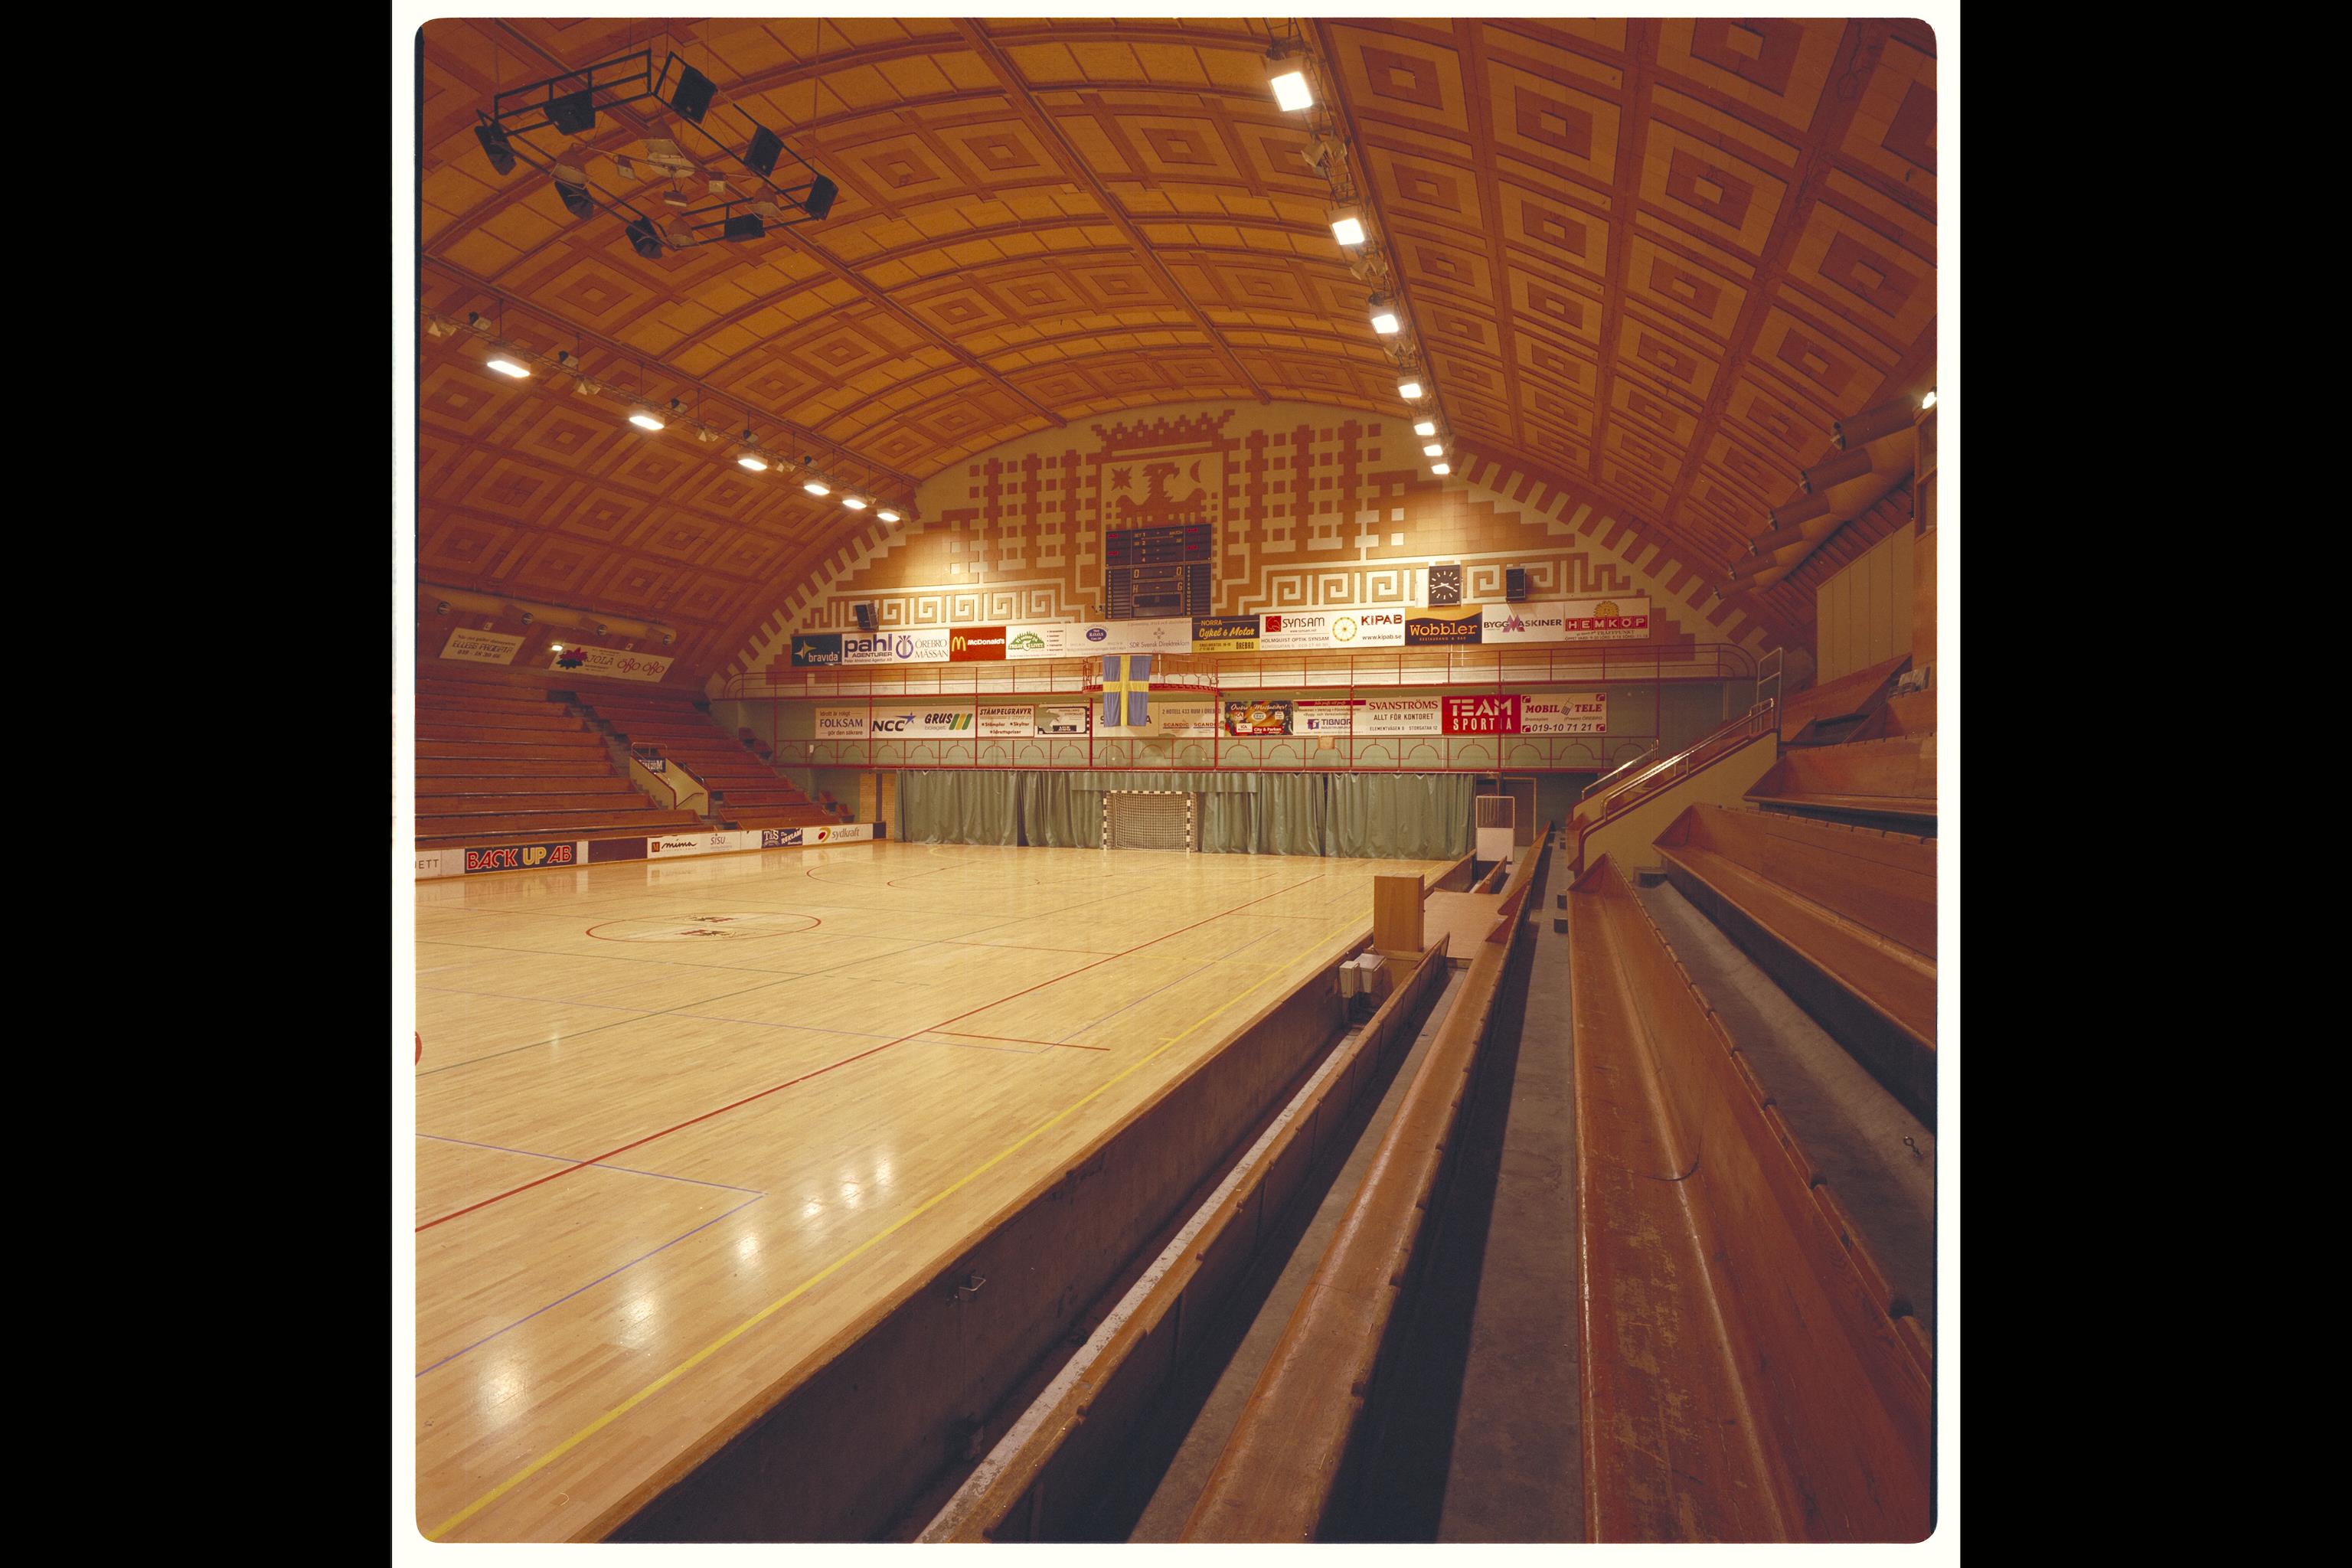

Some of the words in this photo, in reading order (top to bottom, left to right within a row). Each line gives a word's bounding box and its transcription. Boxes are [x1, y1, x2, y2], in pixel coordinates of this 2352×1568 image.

[1282, 617, 1325, 629] SYNSAM
[1361, 614, 1403, 626] KIPAB
[1568, 618, 1645, 629] HEMKÖP
[1199, 628, 1223, 639] Cykel
[1229, 626, 1255, 637] Motor
[1410, 622, 1478, 635] Wobbler
[844, 634, 893, 658] pahl
[915, 638, 947, 648] ÖREBRO
[808, 652, 838, 662] bravida
[915, 649, 949, 659] MÄSSAN
[1369, 700, 1439, 710] SVANSTRÖMS
[1449, 698, 1512, 717] TEAM
[1525, 704, 1560, 714] MOBIL
[1574, 704, 1602, 713] TELE
[820, 719, 863, 727] FOLKSAM
[924, 714, 953, 724] GRUS
[871, 720, 905, 731] NCC
[1532, 724, 1563, 732] 019-10
[1581, 723, 1592, 731] 21
[781, 828, 802, 844] REKLAM
[831, 827, 860, 841] sydkraft
[466, 848, 518, 870] BACK
[522, 847, 547, 866] UP
[547, 845, 572, 864] AB
[415, 859, 439, 869] ETT
